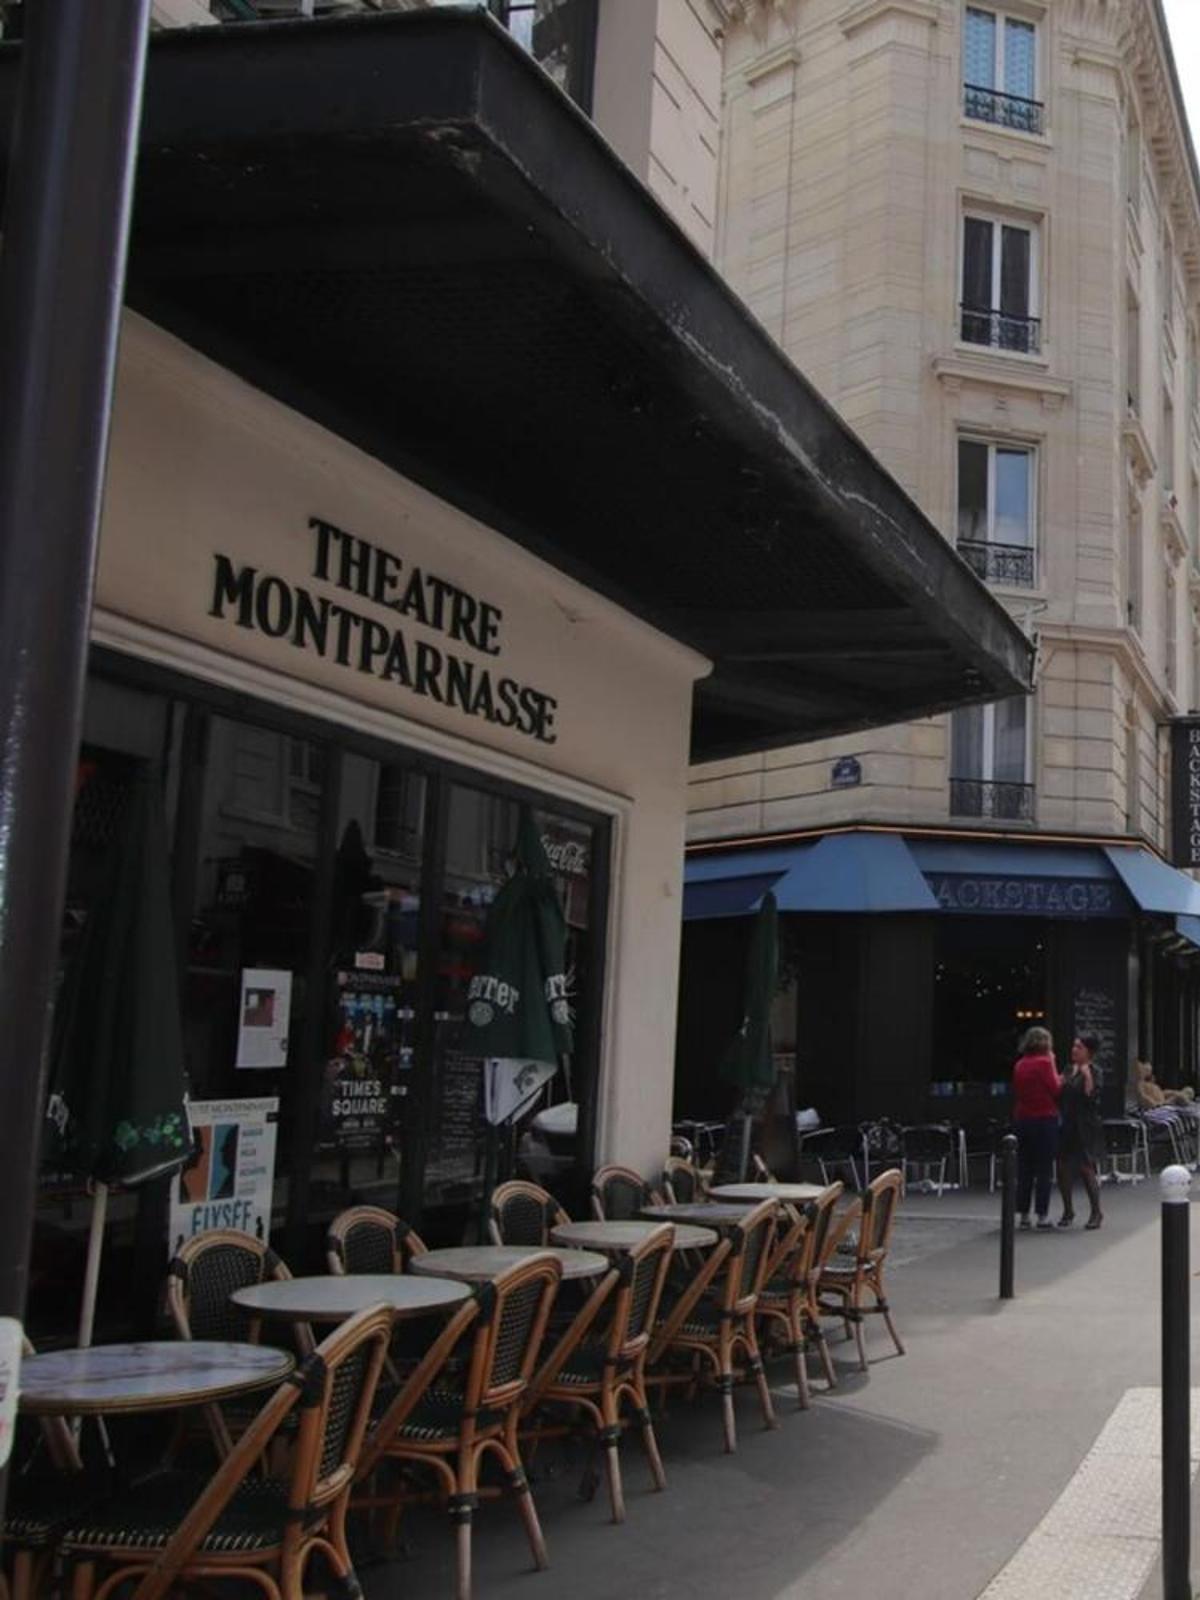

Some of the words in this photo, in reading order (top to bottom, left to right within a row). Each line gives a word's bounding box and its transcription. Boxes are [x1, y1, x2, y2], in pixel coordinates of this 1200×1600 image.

[309, 519, 502, 656] THEATRE
[208, 554, 557, 745] MONTPARNASSE
[933, 878, 1112, 912] ACKSTAGE
[341, 1081, 382, 1096] TIMES
[332, 1099, 388, 1116] SQUARE
